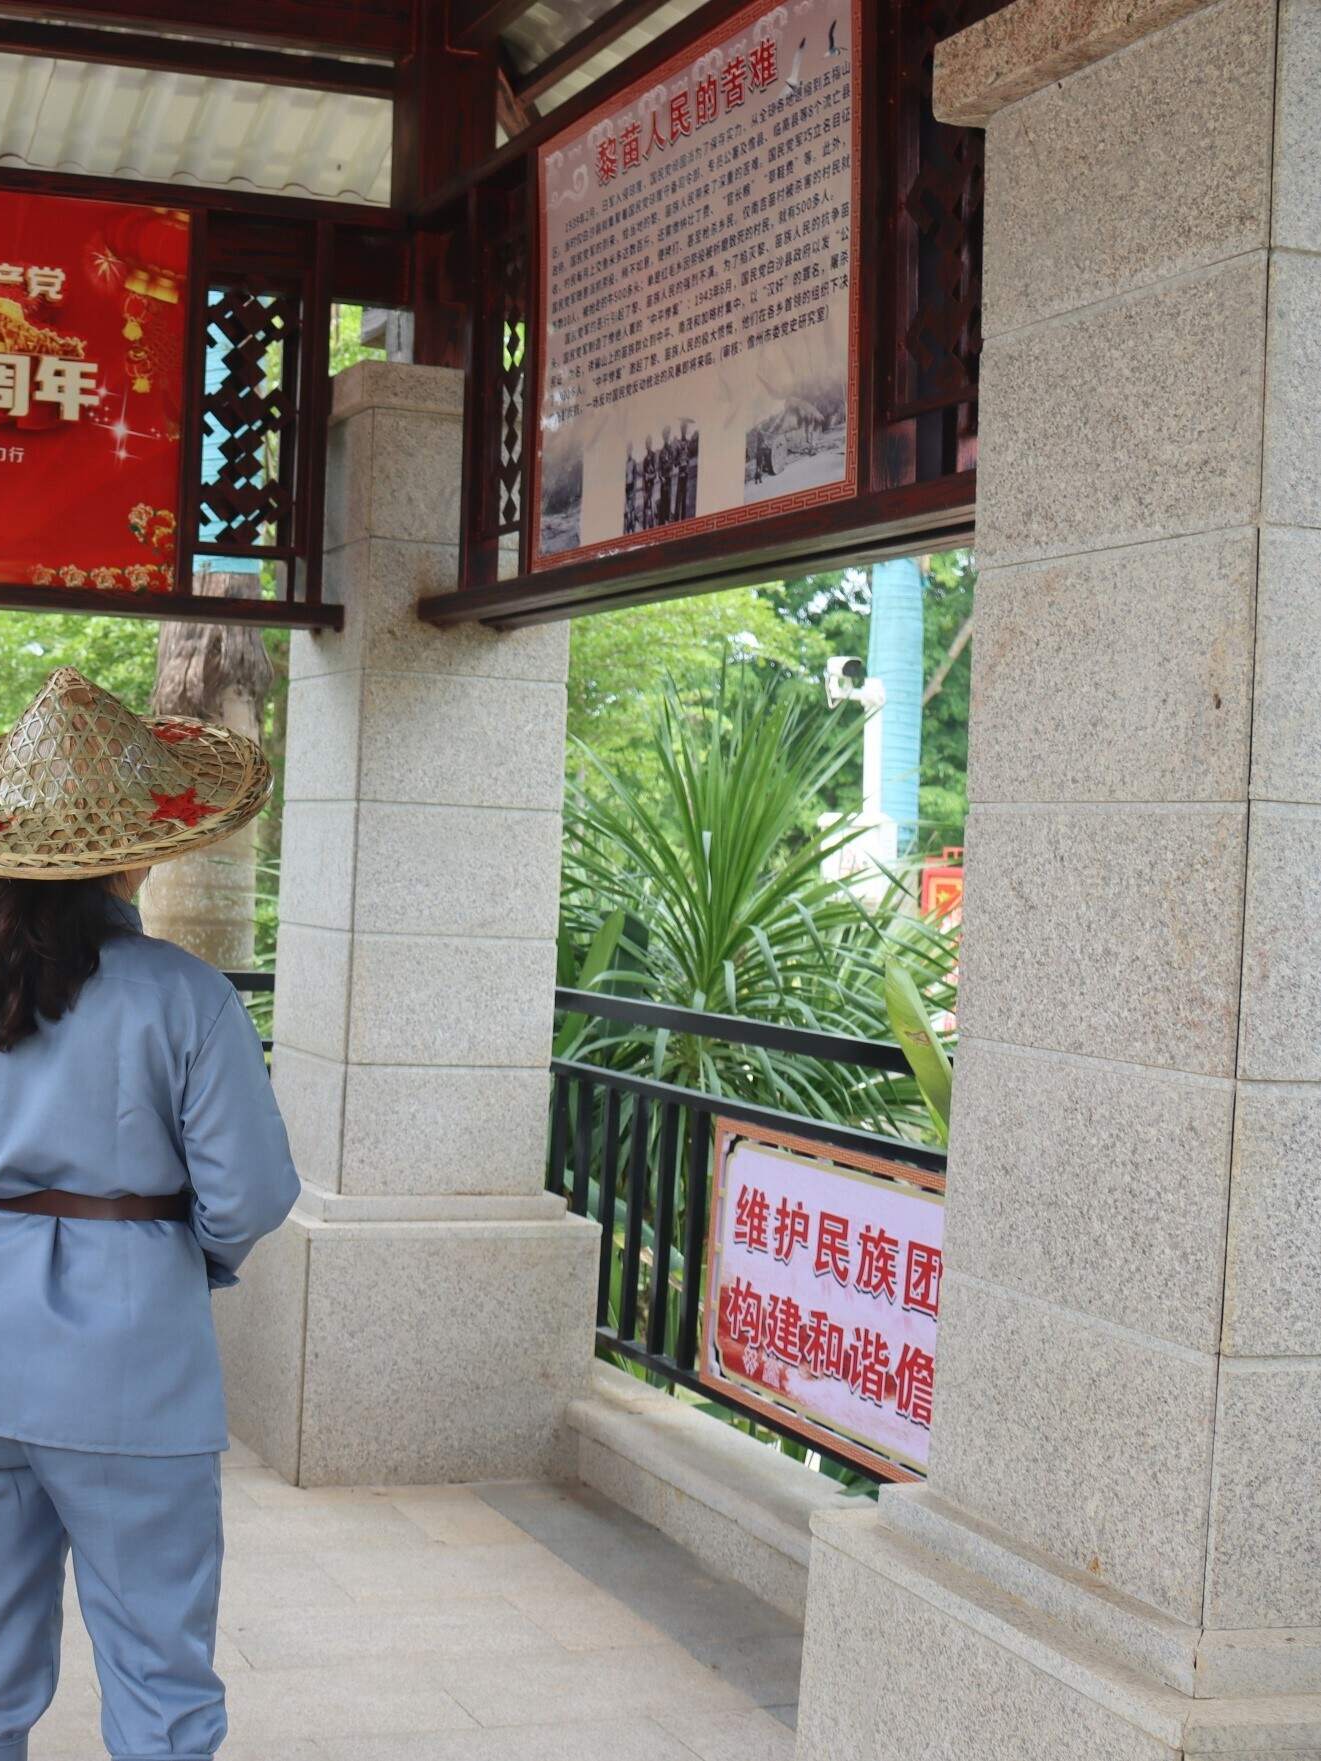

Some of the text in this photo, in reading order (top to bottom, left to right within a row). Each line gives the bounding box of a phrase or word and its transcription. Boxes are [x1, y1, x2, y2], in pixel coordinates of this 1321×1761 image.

[596, 38, 778, 186] 黎苗人民的苦难
[734, 1184, 943, 1317] 维护民族团
[727, 1276, 934, 1429] 构建和谐儋
